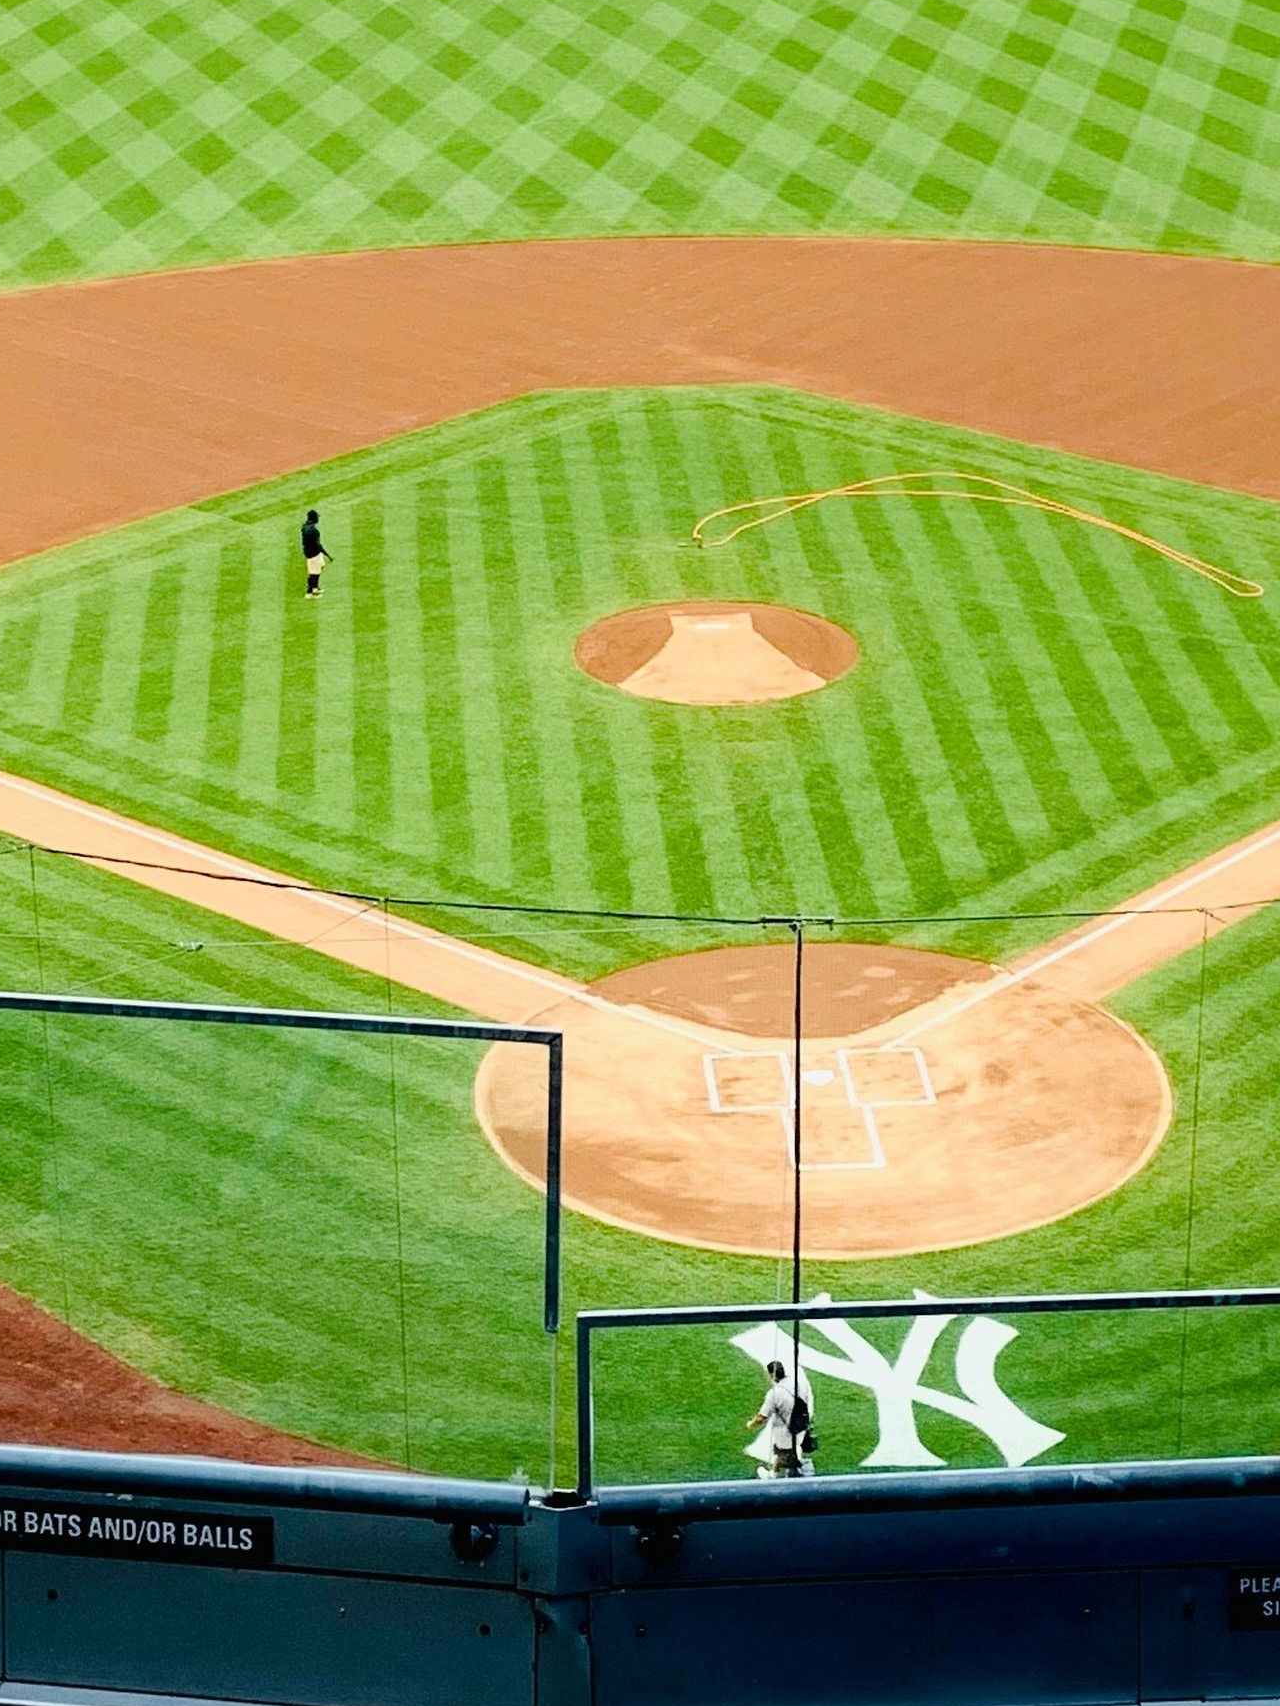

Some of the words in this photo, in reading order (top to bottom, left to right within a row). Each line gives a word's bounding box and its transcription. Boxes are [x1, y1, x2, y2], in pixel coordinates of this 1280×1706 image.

[727, 1288, 1068, 1468] NY
[23, 1510, 82, 1538] BATS
[87, 1515, 177, 1546] AND/OR
[183, 1522, 253, 1551] BALLS
